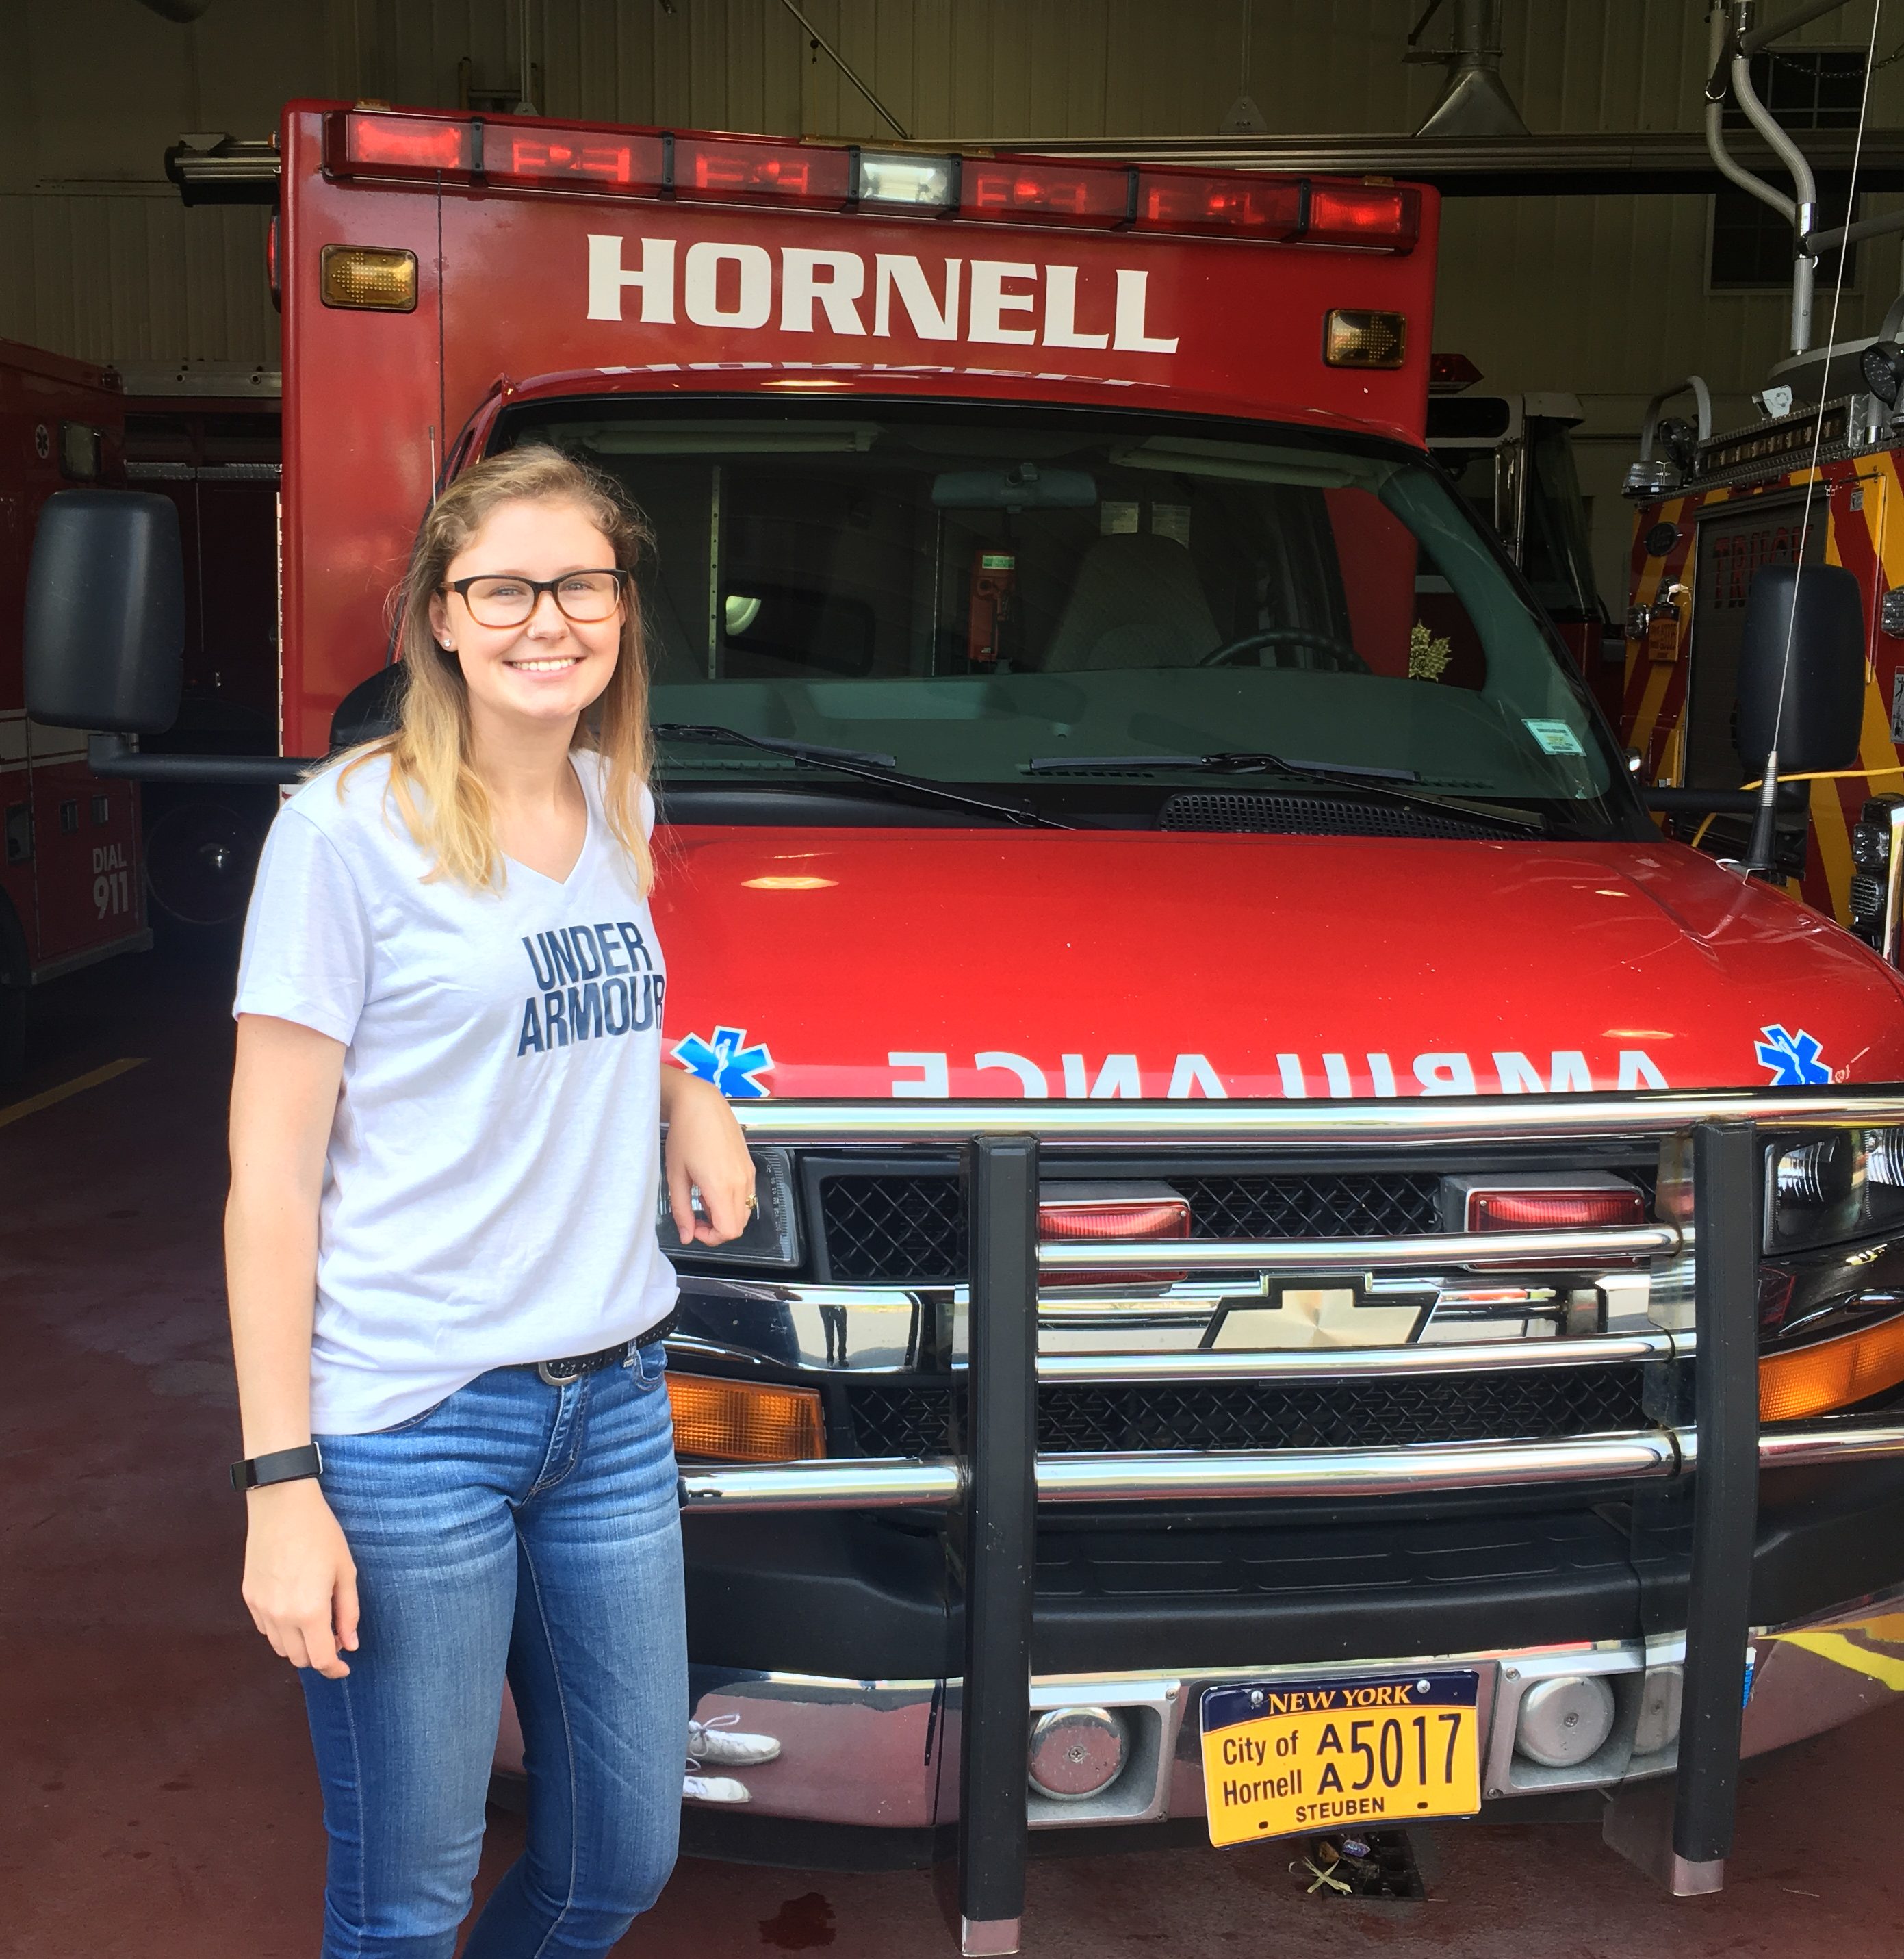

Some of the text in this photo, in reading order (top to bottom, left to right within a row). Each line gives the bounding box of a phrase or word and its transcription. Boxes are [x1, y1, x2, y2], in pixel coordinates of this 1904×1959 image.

[585, 233, 1179, 354] HORNELL
[93, 843, 127, 874] DIAL
[93, 871, 129, 920] 911
[522, 921, 653, 991] UNDER
[517, 975, 665, 1057] ARMOUR
[1268, 1685, 1413, 1715] NEW YORK
[1223, 1730, 1298, 1766] City of
[1223, 1769, 1302, 1807] Hornell
[1296, 1797, 1385, 1823] STEUBEN
